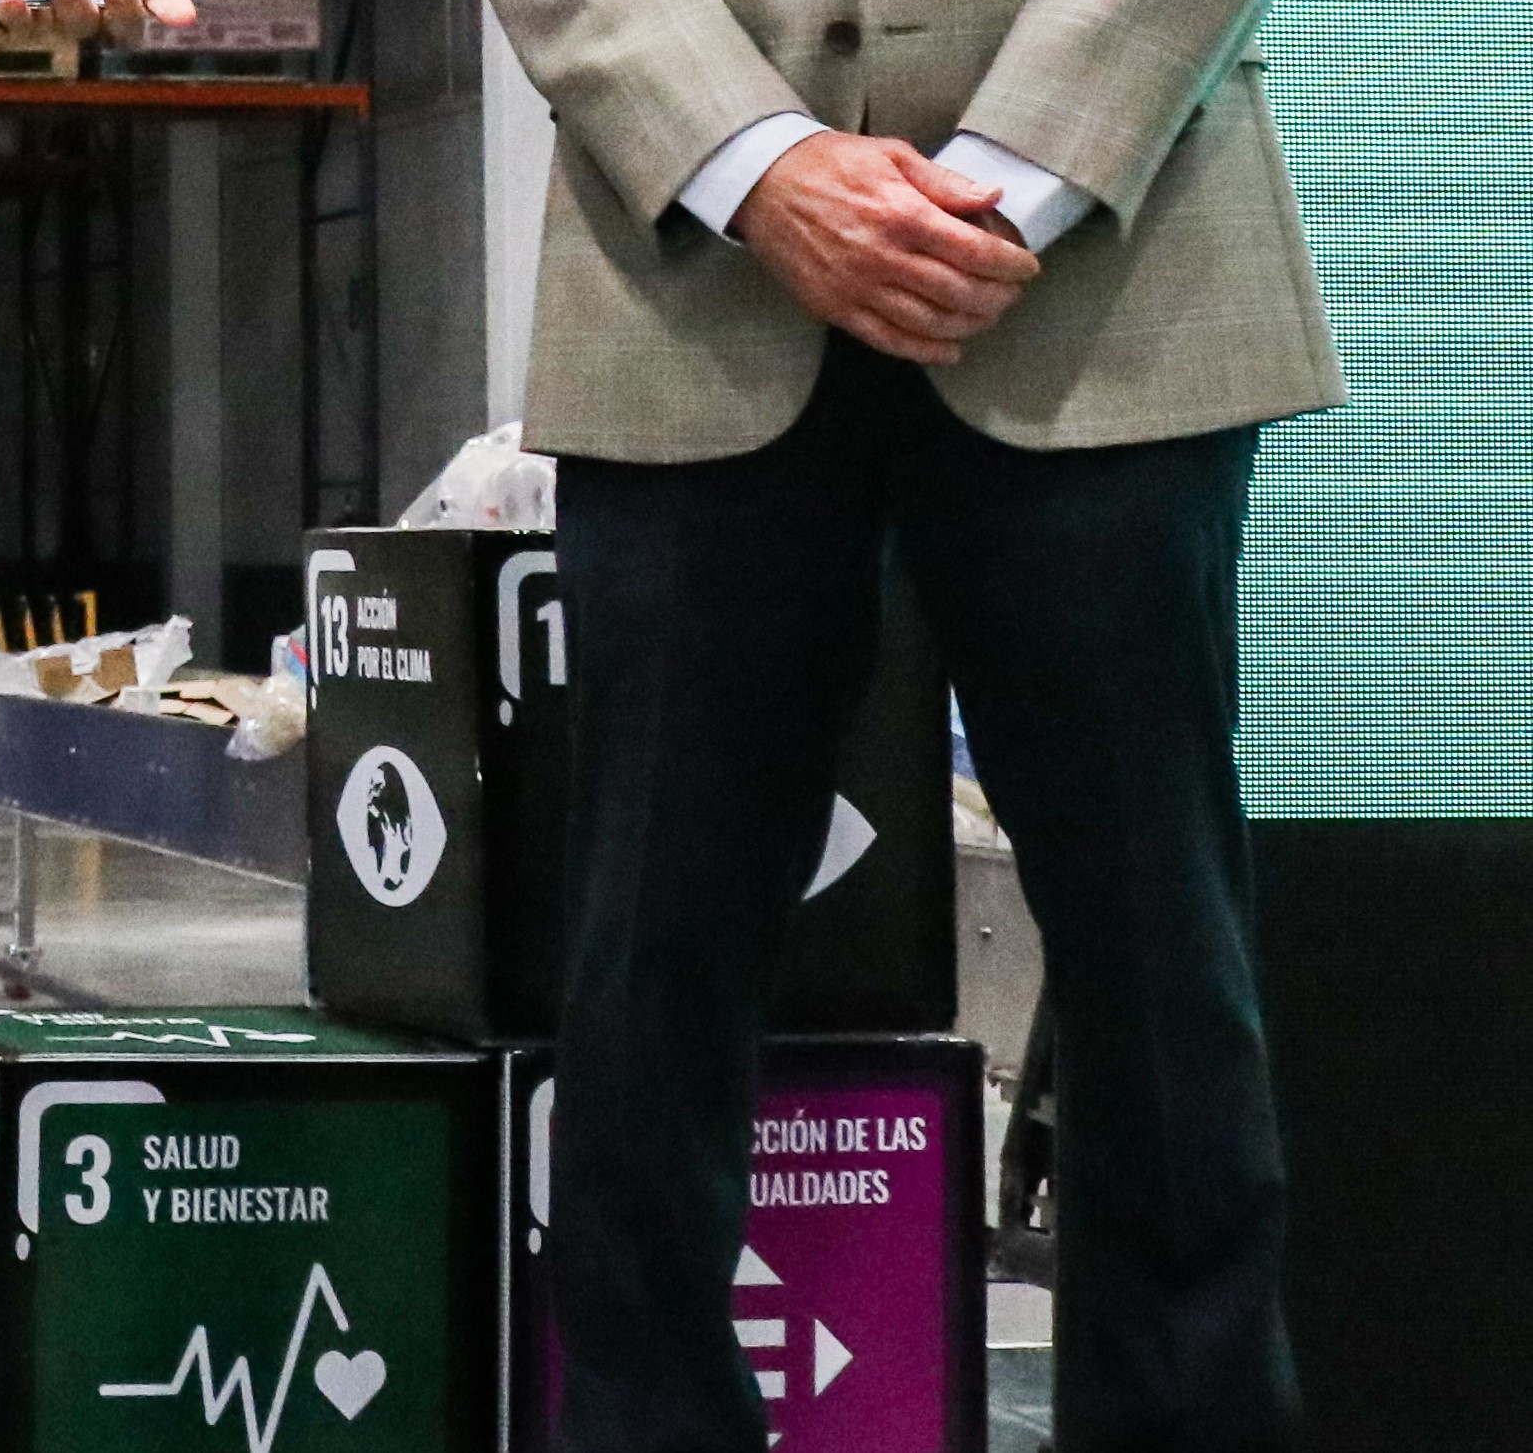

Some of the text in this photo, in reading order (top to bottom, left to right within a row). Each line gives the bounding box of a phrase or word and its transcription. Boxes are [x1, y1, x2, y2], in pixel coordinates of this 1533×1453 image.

[321, 595, 349, 677] 13
[357, 645, 433, 684] POR EL CLIMA
[143, 1134, 240, 1171] SALUD
[836, 1118, 870, 1153] DE
[877, 1116, 928, 1152] LAS
[65, 1134, 112, 1226] 3
[142, 1187, 330, 1224] Y BIENESTAR
